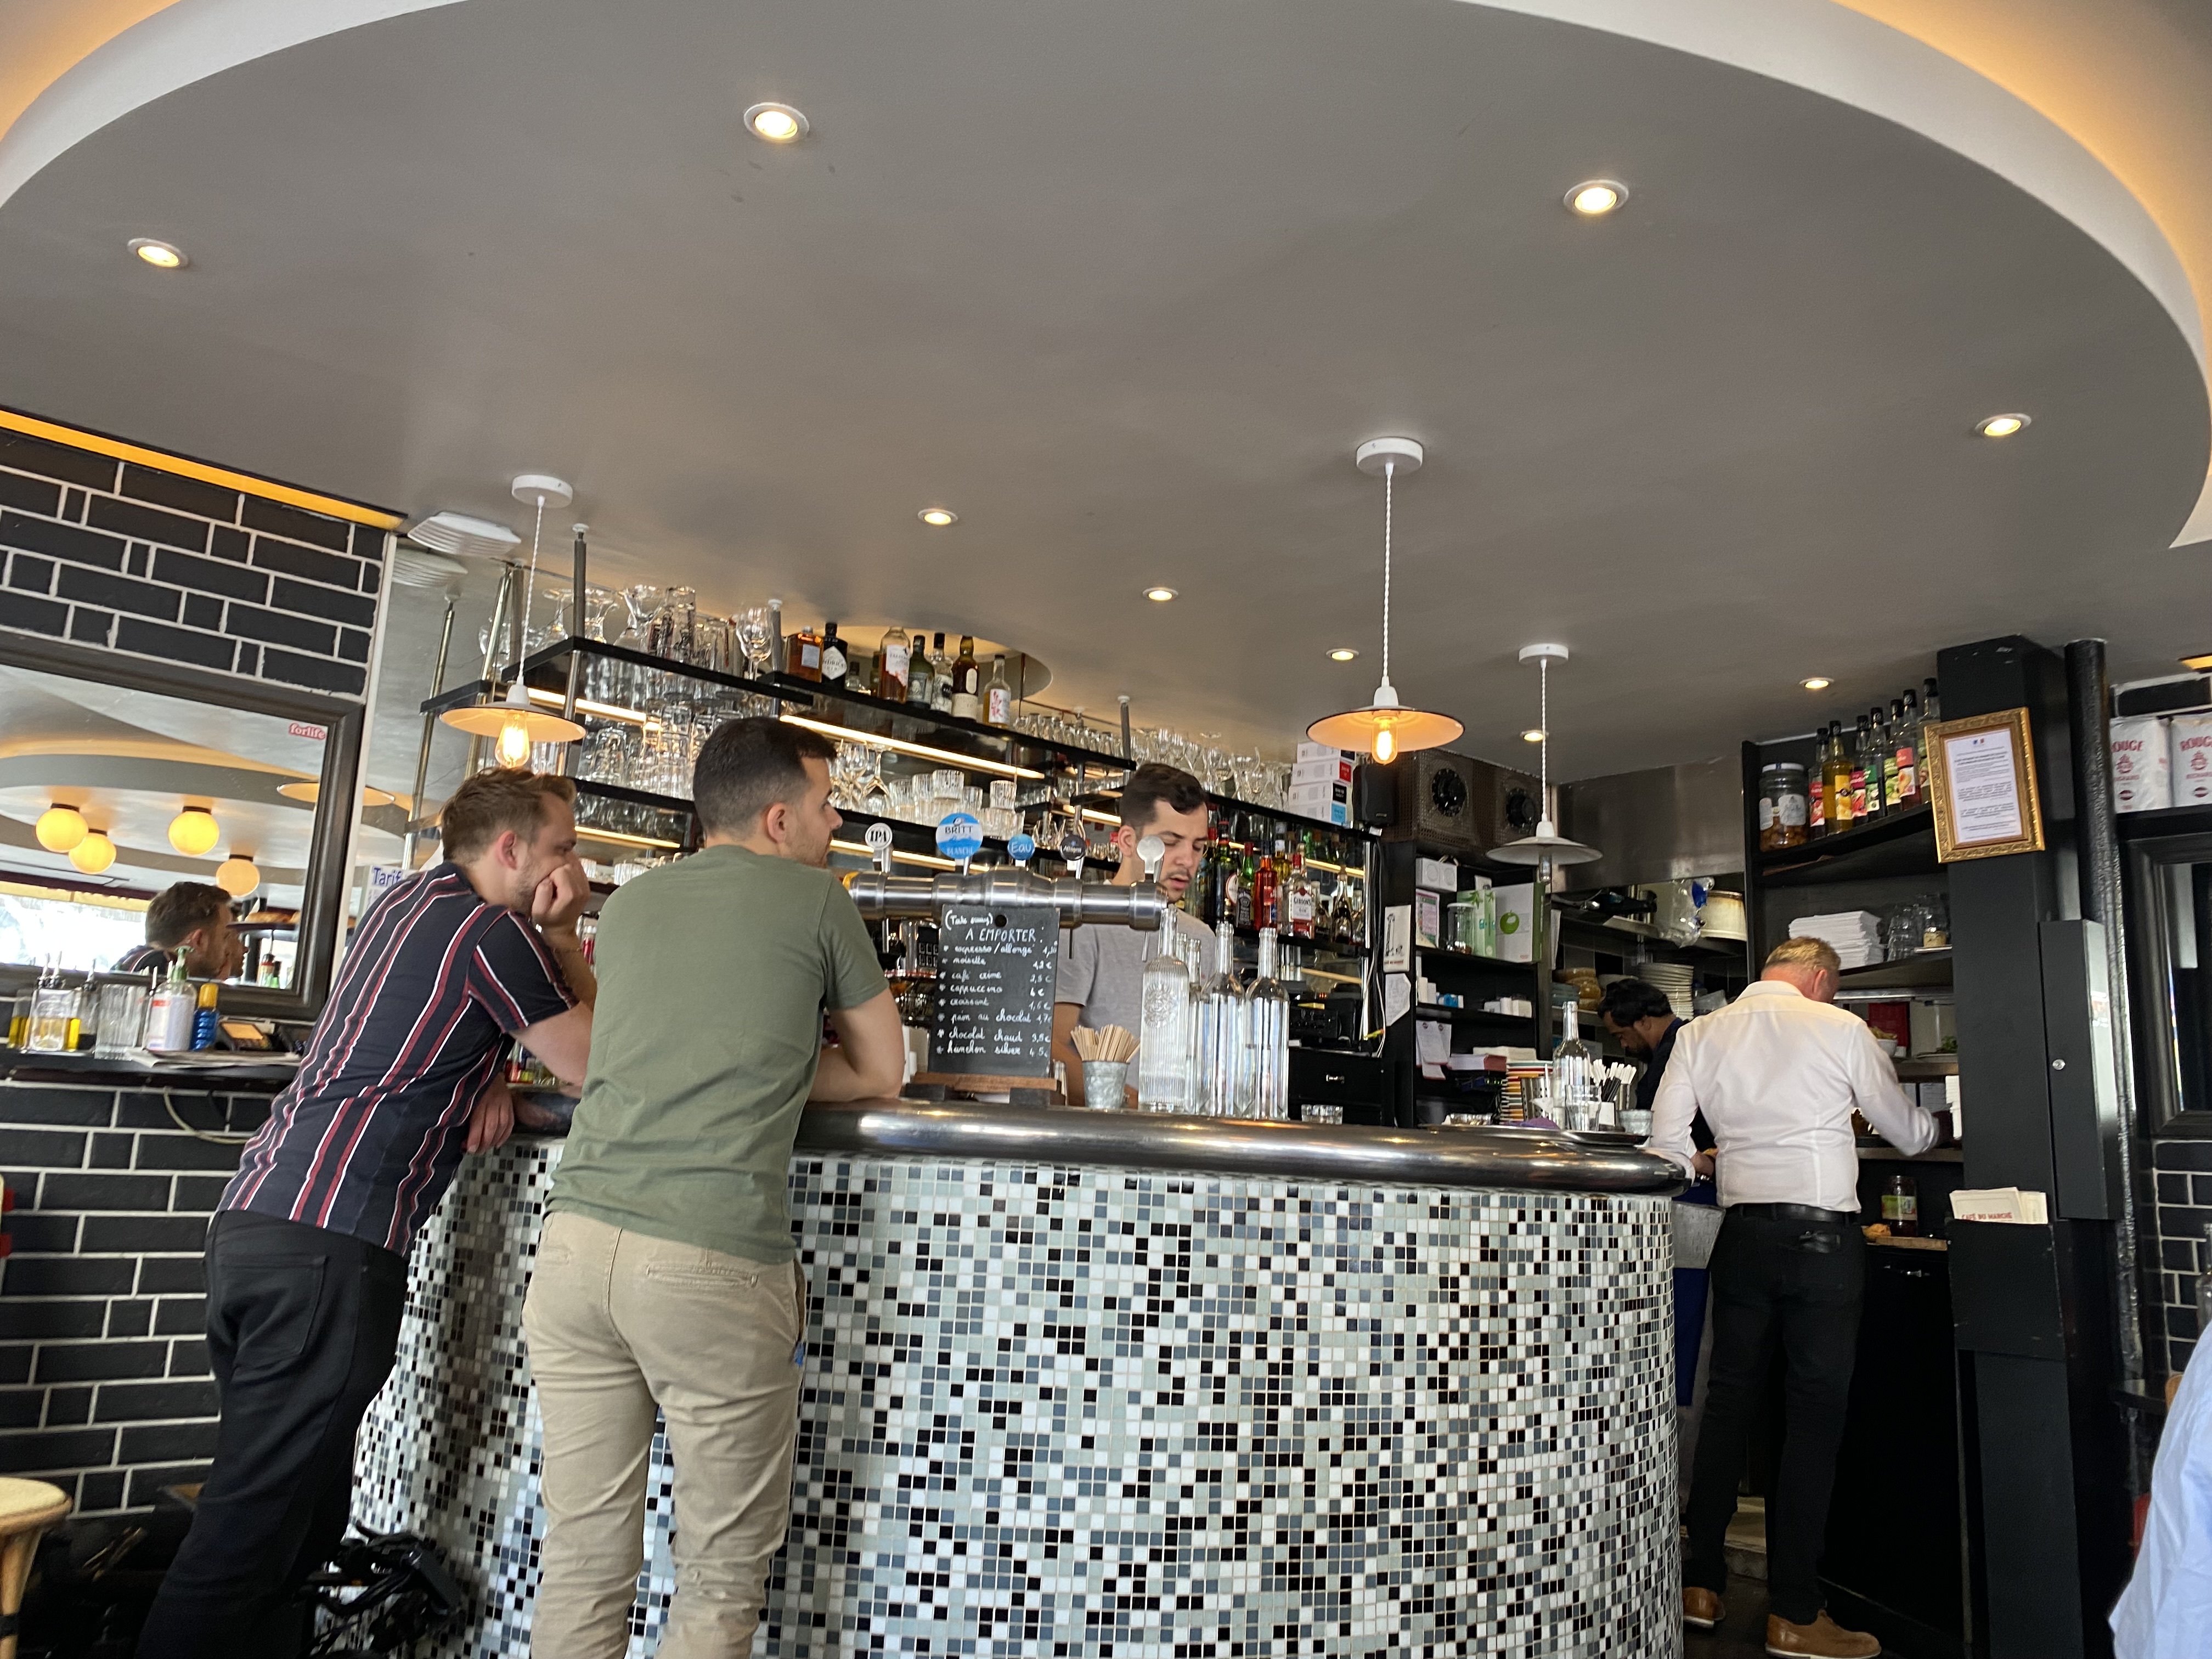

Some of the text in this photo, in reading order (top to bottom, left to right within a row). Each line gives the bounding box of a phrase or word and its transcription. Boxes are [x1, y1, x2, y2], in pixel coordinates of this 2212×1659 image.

[290, 723, 325, 739] forlife
[2180, 736, 2212, 752] ROUG
[945, 825, 973, 834] BRITT
[870, 830, 887, 844] IPA
[947, 846, 973, 856] BLANCHE
[1011, 841, 1031, 854] Eau
[965, 928, 974, 941] A
[979, 928, 1036, 943] EMPORTER
[953, 955, 986, 966] noisette
[950, 984, 1003, 995] cappuccino
[950, 997, 989, 1007] croissant
[951, 1010, 970, 1025] pain
[996, 1008, 1031, 1023] chocolat
[949, 1025, 985, 1040] chocolat
[994, 1028, 1023, 1042] chaud
